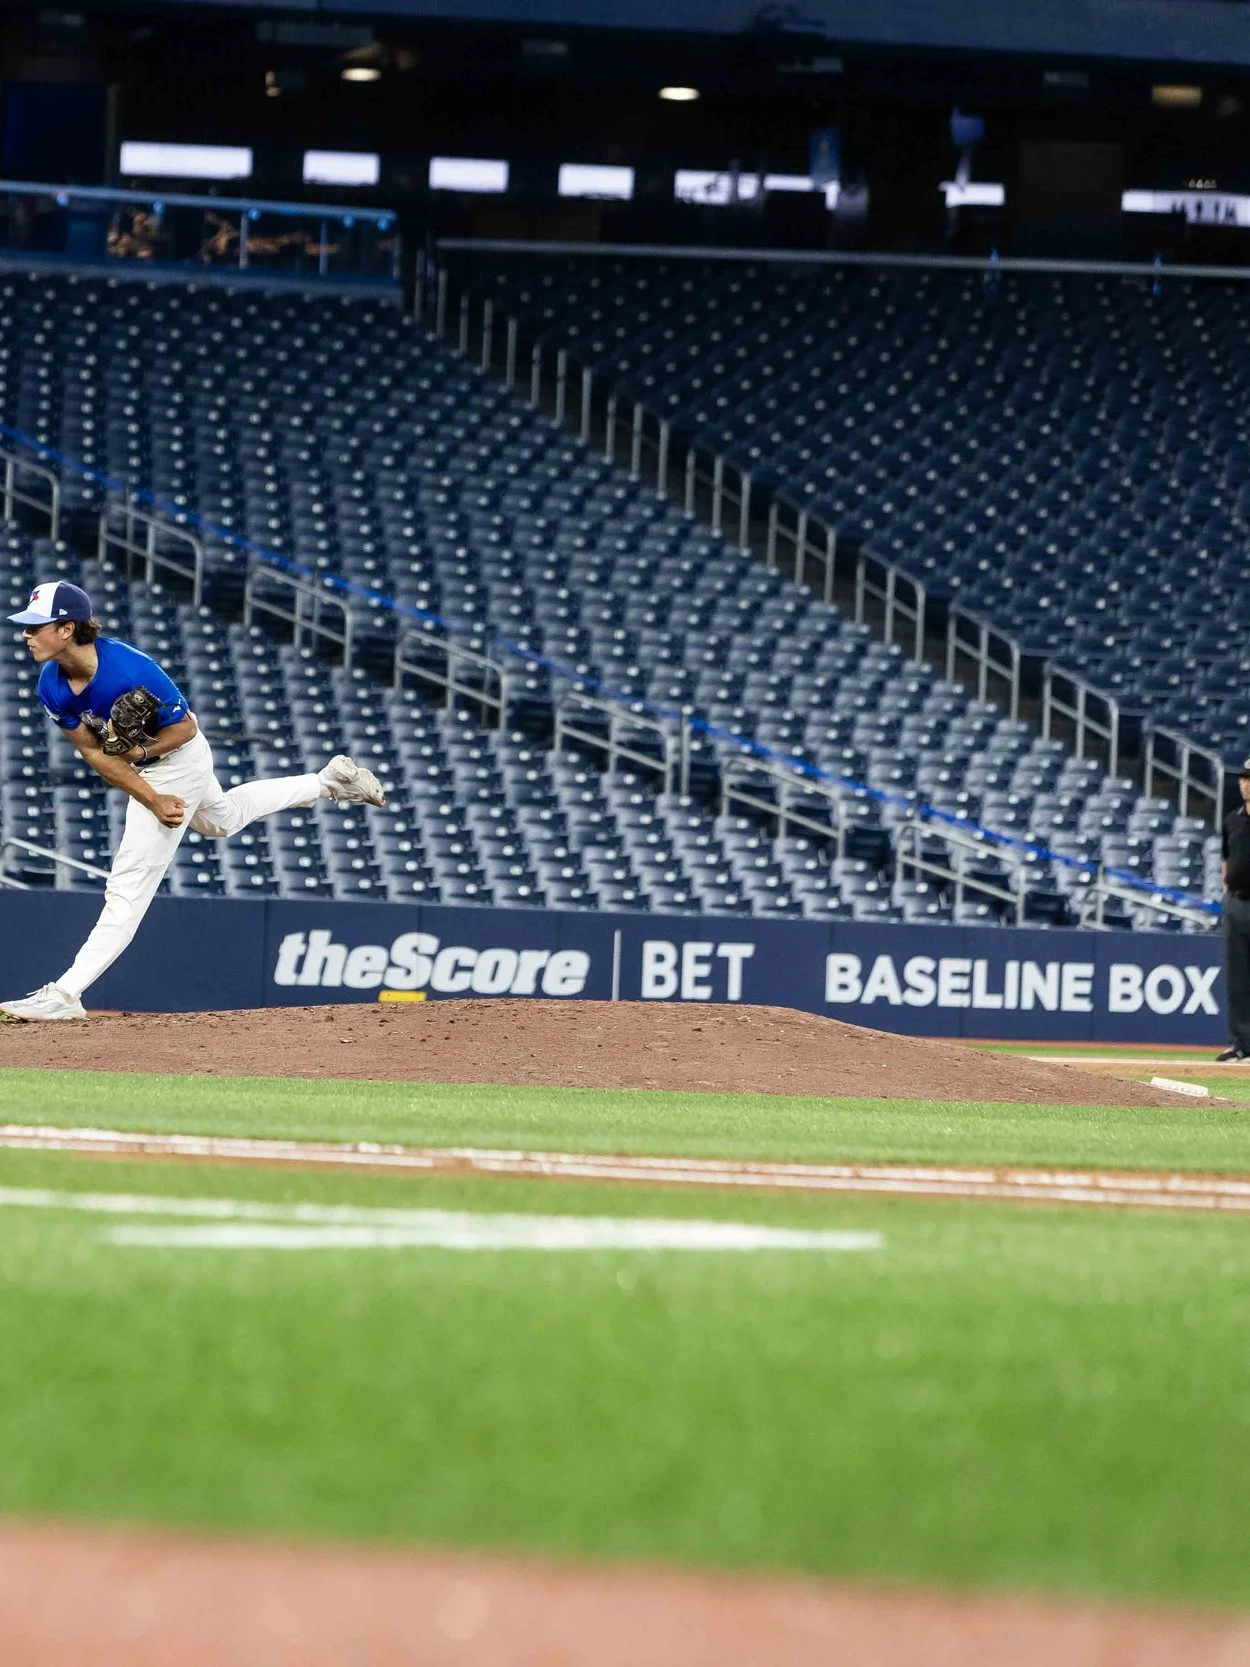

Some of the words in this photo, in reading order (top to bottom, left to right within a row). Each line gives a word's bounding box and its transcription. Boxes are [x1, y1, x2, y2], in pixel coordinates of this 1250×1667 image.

[274, 929, 591, 996] theScore
[641, 940, 755, 1001] BET
[824, 953, 1095, 1012] BASELINE
[1108, 963, 1222, 1015] BOX
